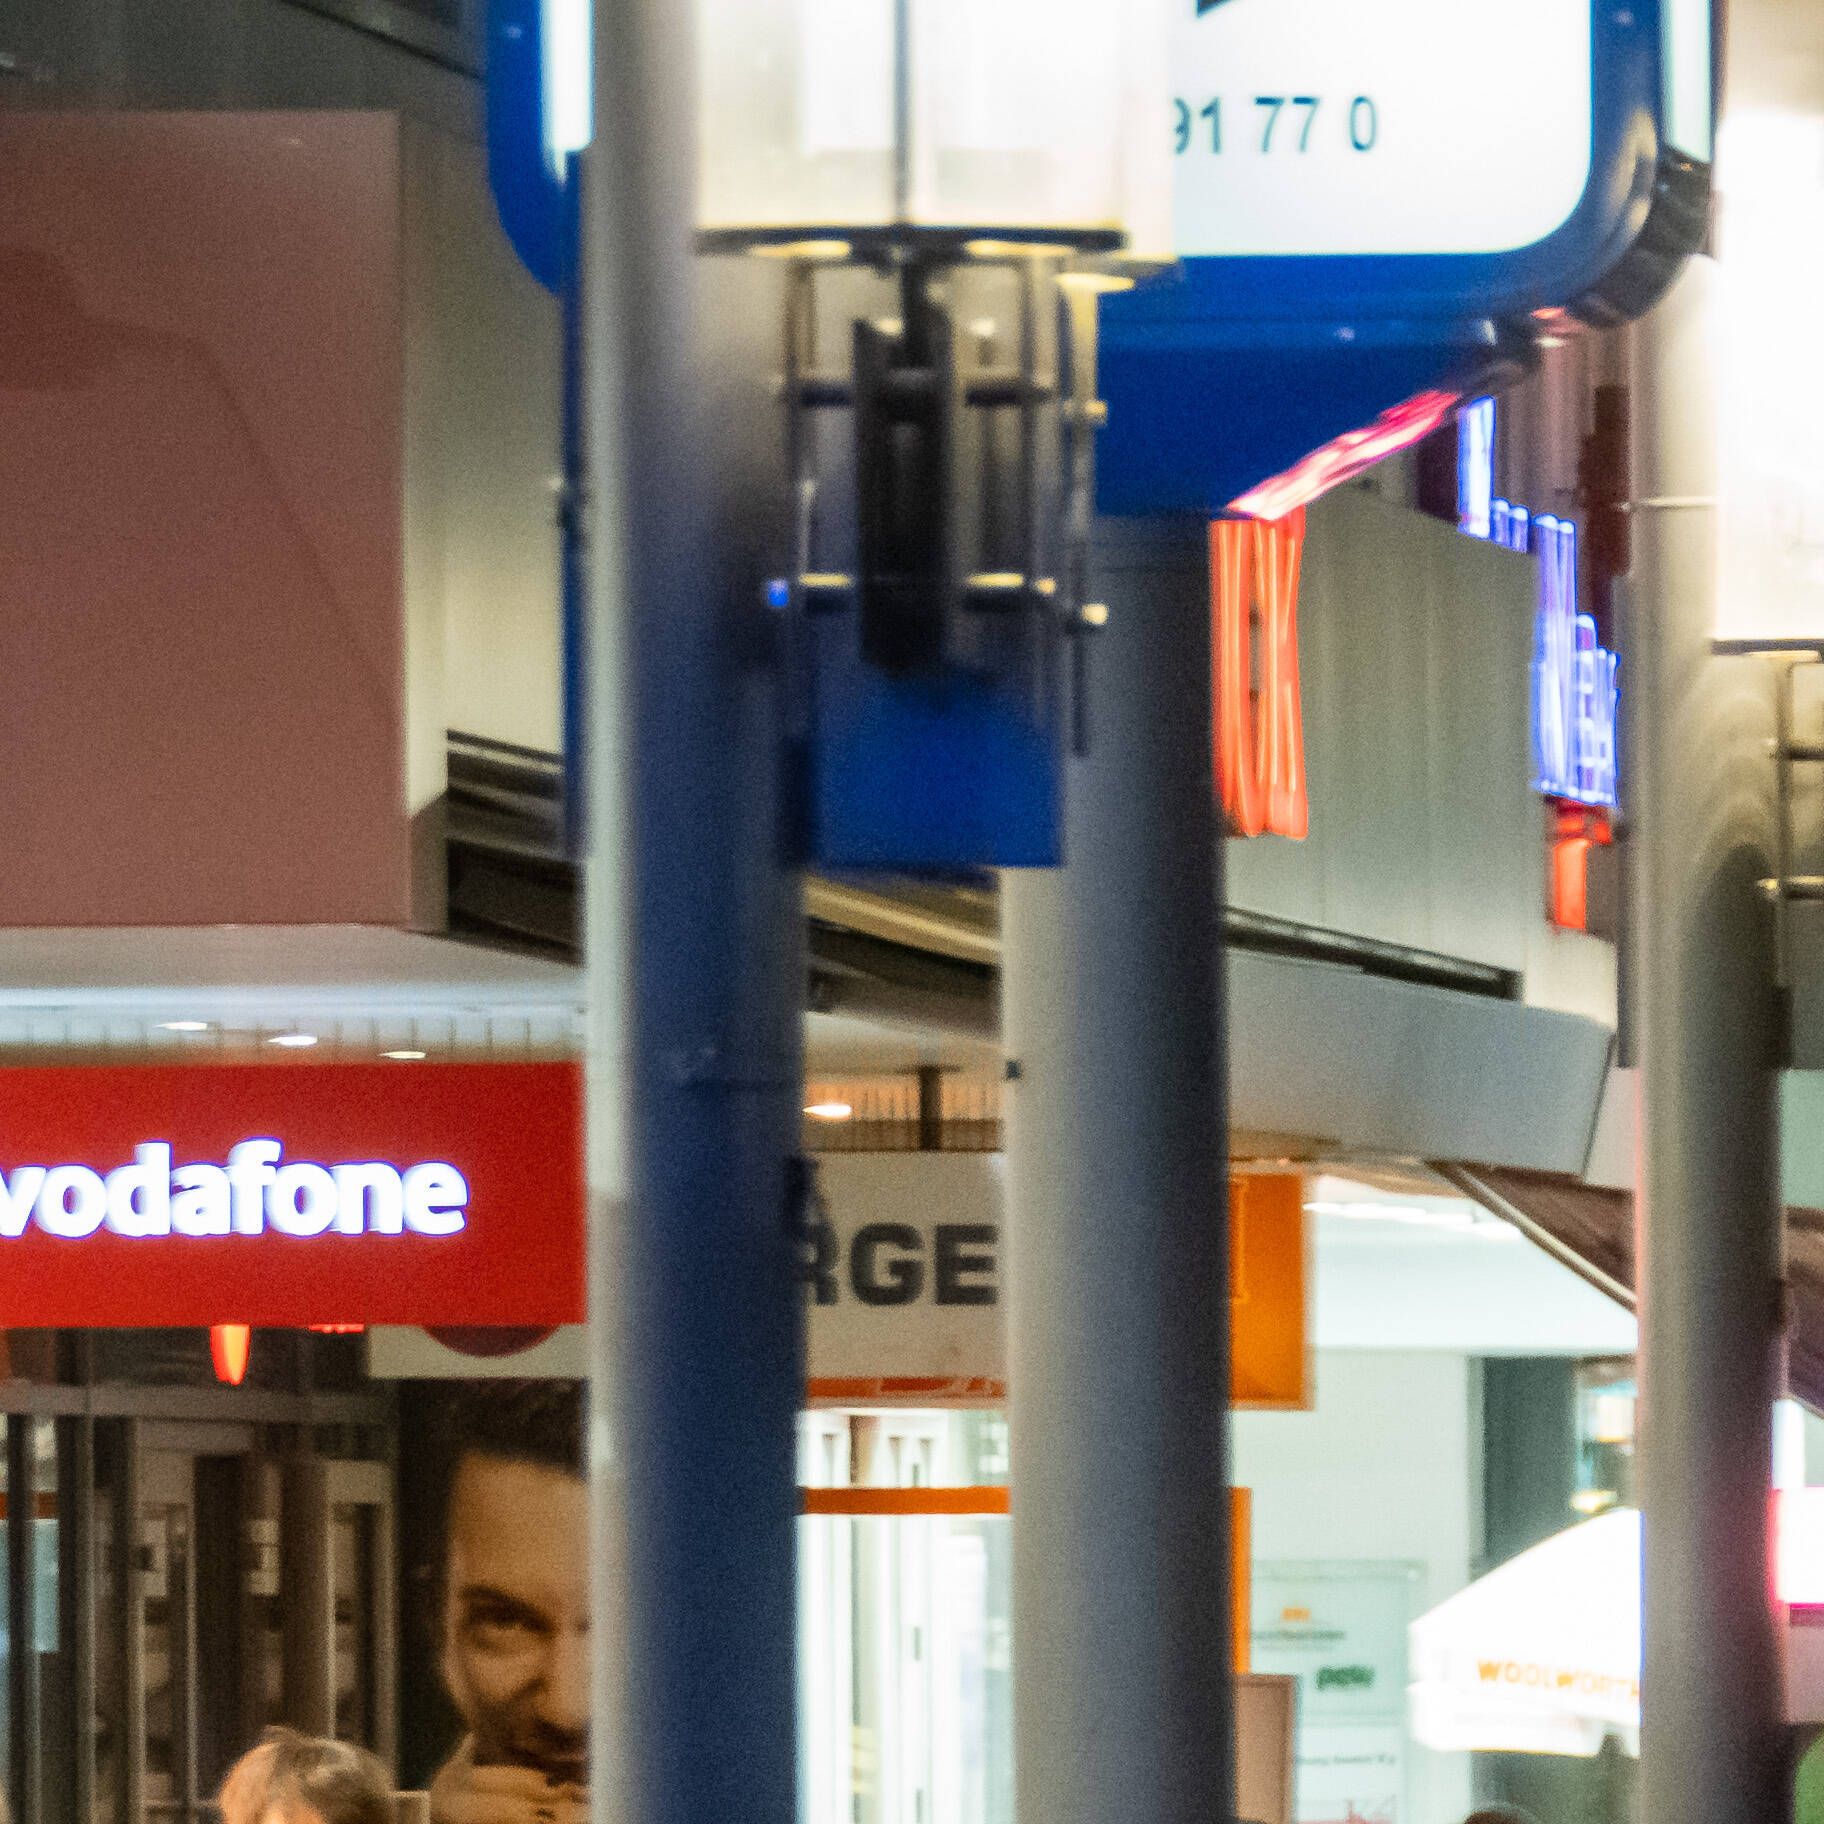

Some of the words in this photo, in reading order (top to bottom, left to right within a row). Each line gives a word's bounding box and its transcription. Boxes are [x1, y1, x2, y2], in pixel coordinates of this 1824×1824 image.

[1253, 95, 1320, 154] 77
[1349, 94, 1378, 153] 0
[0, 1137, 470, 1239] vodafone
